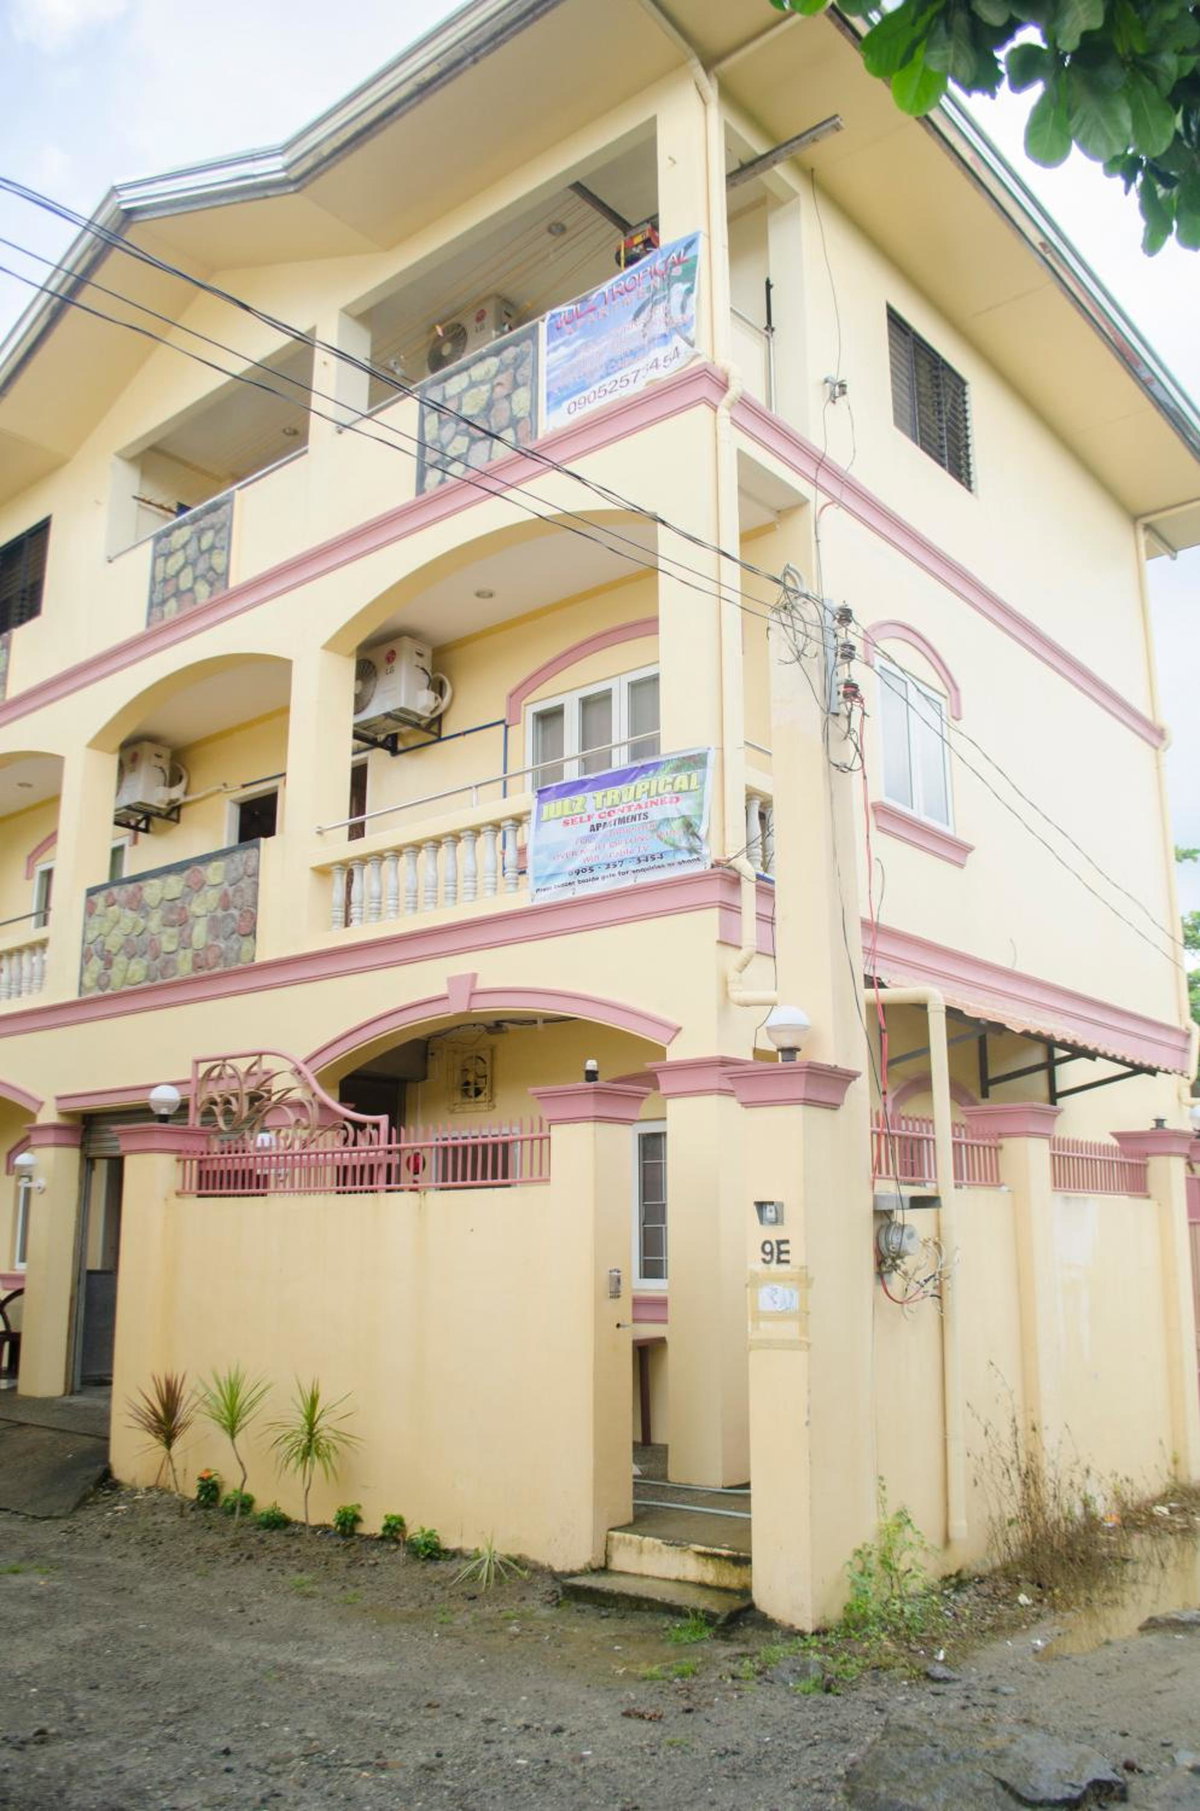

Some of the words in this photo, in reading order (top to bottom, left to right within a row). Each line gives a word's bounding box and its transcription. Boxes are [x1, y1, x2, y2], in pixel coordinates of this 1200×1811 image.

[593, 772, 700, 809] TROPICAL
[561, 813, 594, 828] SELF
[598, 796, 681, 820] CONTAINED
[760, 1239, 791, 1265] 9E
